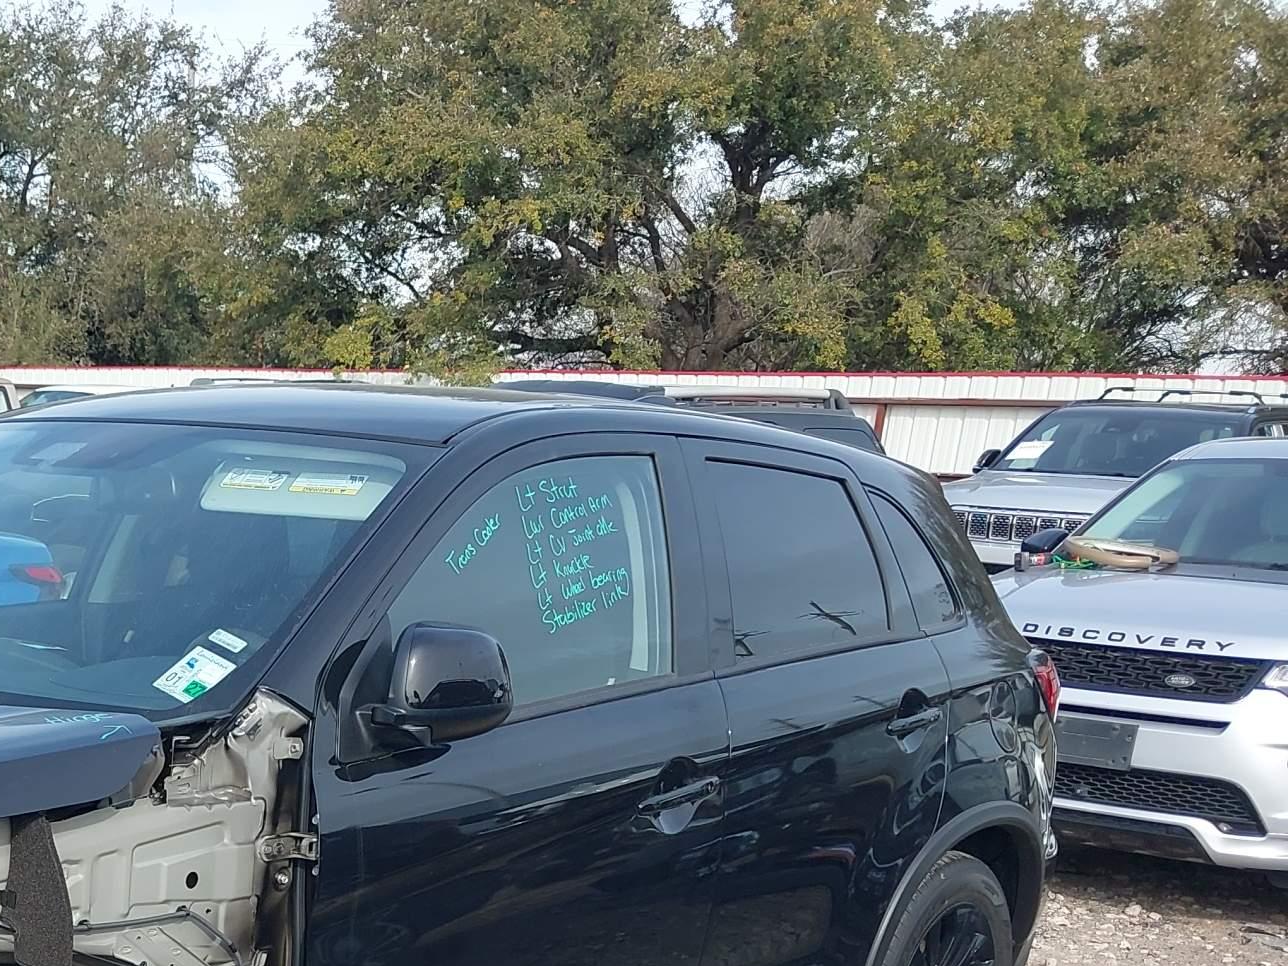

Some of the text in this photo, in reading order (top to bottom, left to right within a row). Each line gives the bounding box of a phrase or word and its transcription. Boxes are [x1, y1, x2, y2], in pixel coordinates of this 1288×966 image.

[515, 477, 578, 512] Lt Strut
[550, 502, 588, 529] Control
[588, 493, 613, 513] Arm
[445, 513, 500, 575] Trans Cooler
[527, 540, 542, 564] Lt
[530, 554, 595, 588] Lt Knuckle
[538, 587, 553, 610] Lt
[589, 567, 630, 596] bearing
[542, 583, 630, 634] Stabilizer link
[1022, 622, 1236, 651] DISCOVERY
[165, 671, 184, 686] 01
[186, 682, 206, 696] 27
